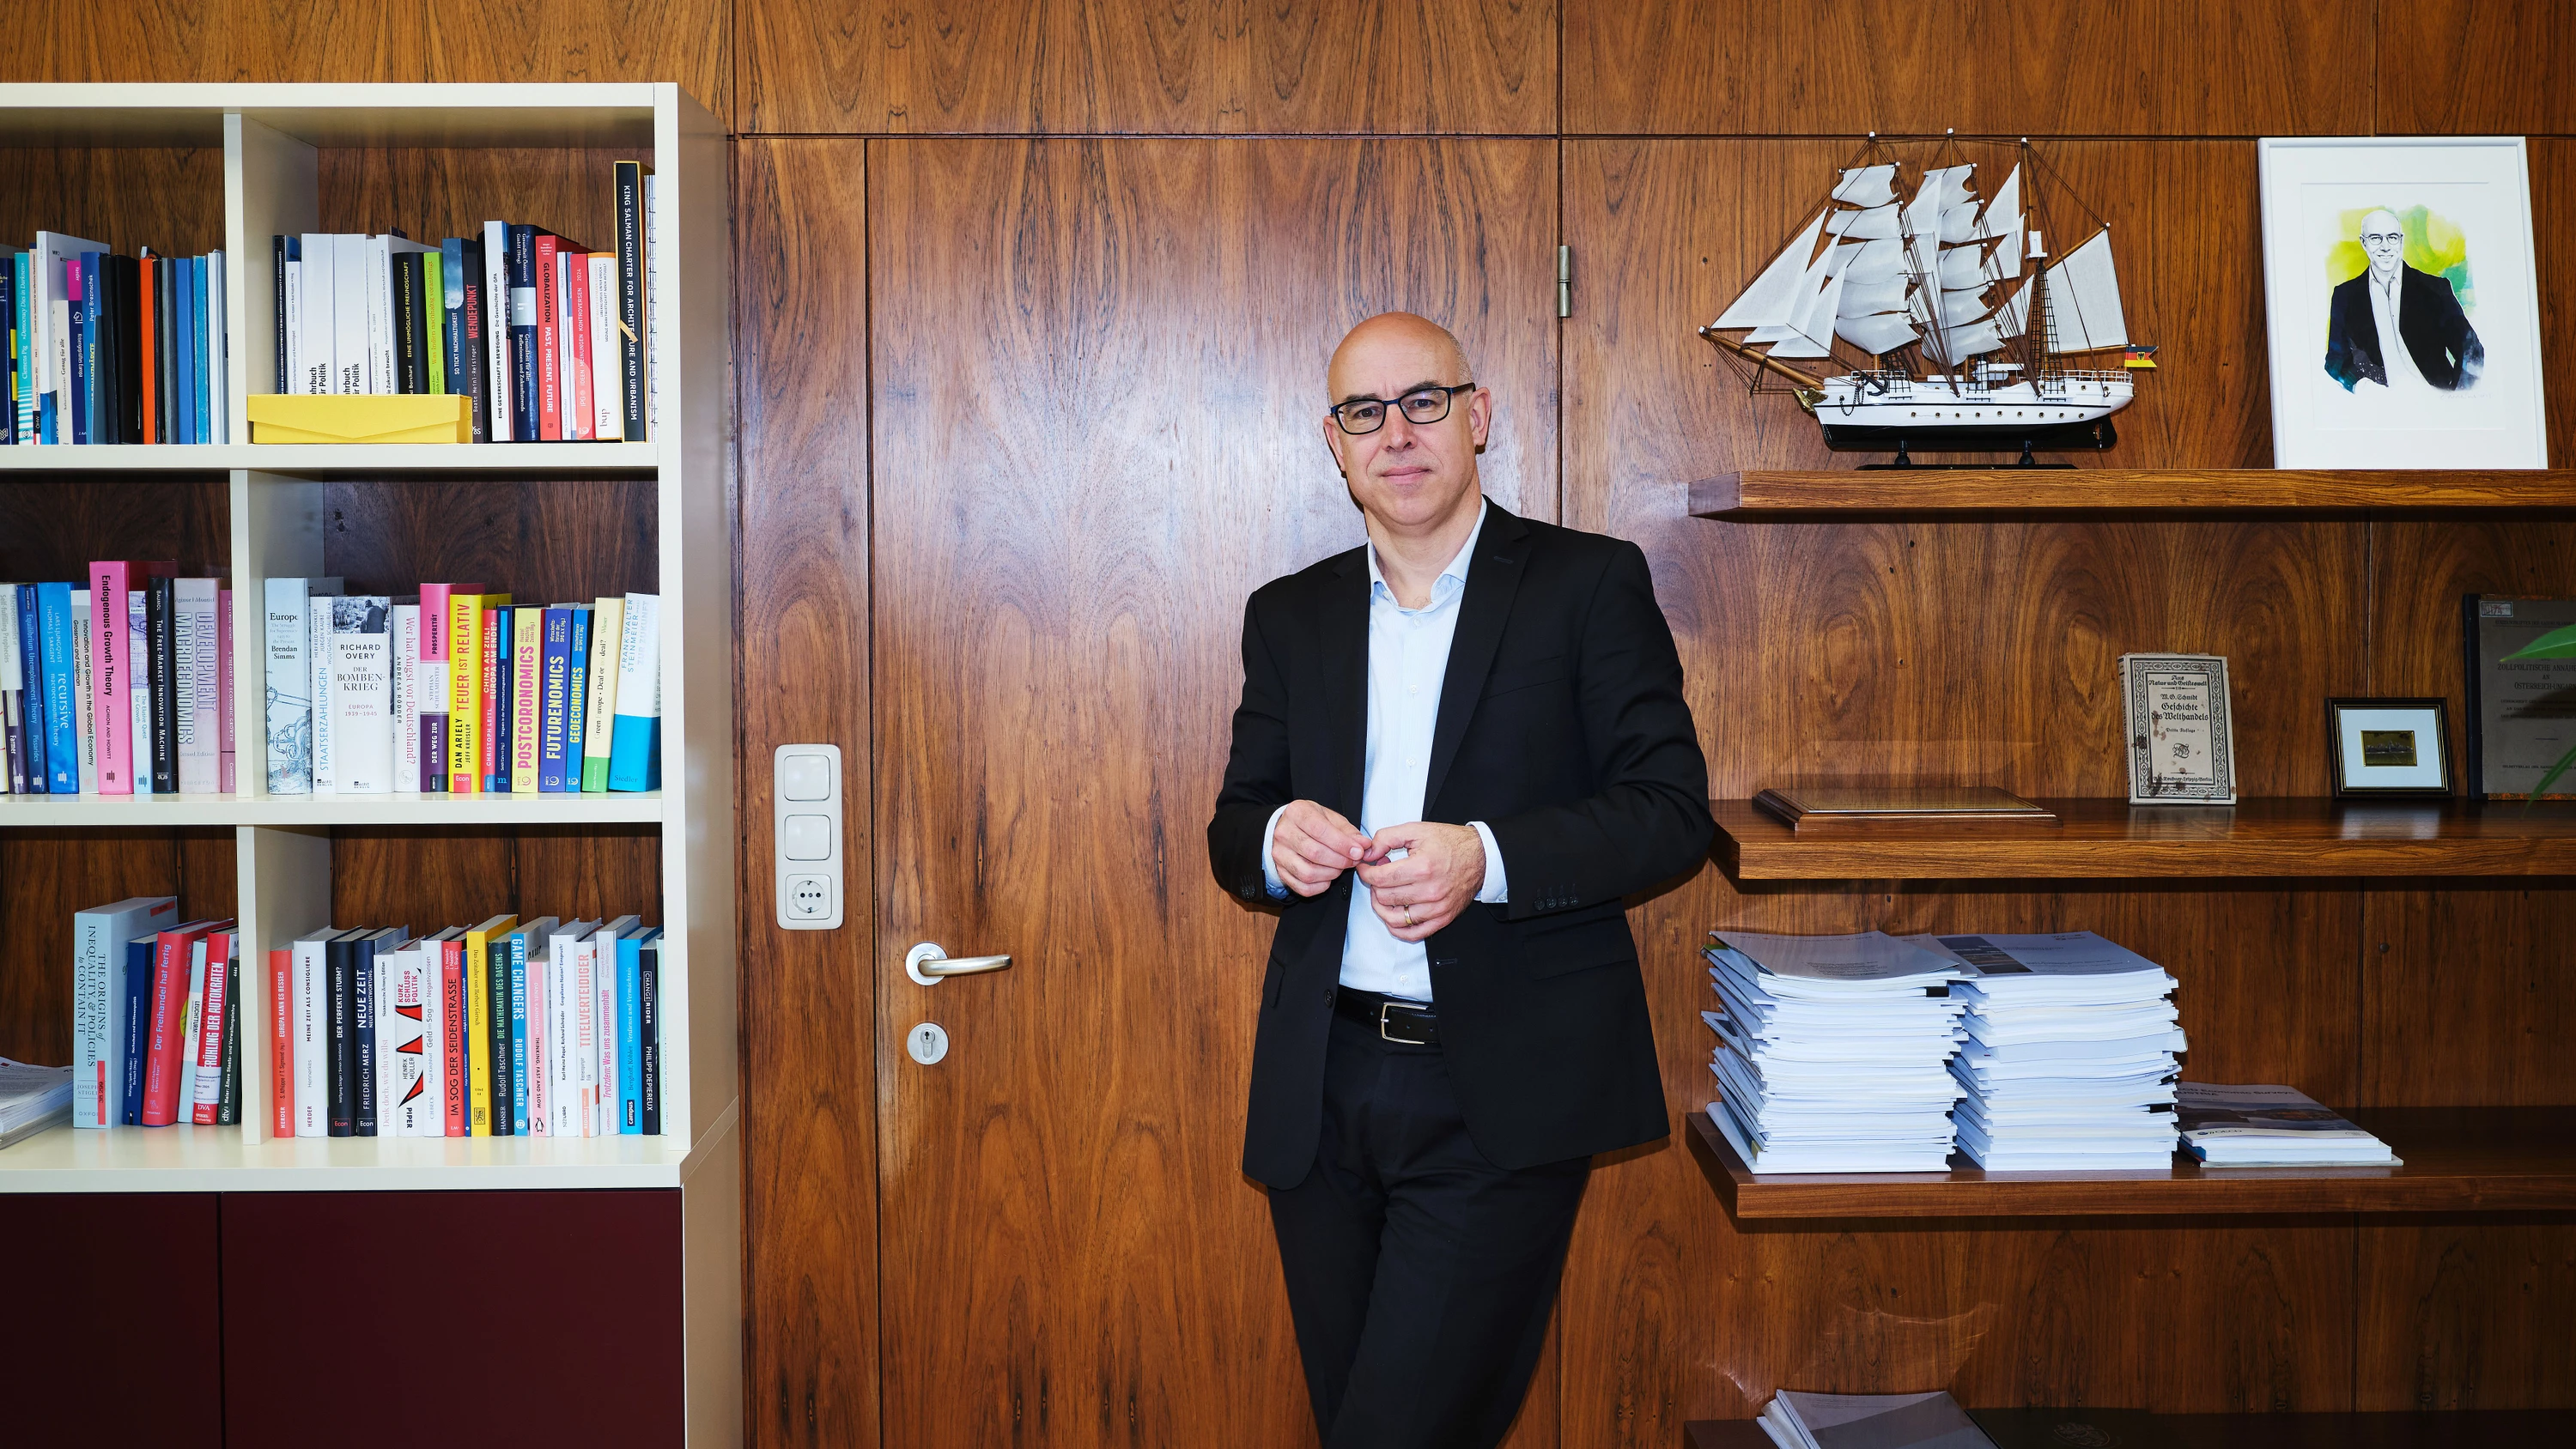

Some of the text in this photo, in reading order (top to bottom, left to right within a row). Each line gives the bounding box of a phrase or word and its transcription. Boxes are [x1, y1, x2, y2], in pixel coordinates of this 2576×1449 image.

[466, 284, 478, 339] WENDEPUNKT
[543, 262, 551, 323] GLOBALIZATION
[577, 334, 587, 368] MEINUNGEN
[627, 298, 636, 357] ARCHITETURE
[318, 363, 326, 387] Politik
[351, 363, 360, 387] Politik
[629, 378, 638, 420] URBANISM
[25, 614, 35, 651] Equilibrium
[100, 575, 114, 696] Endogenous Growth Theory
[456, 603, 470, 712] TEUER IST RELATIV
[484, 651, 490, 664] AM
[490, 650, 497, 664] AM
[28, 652, 38, 702] Unemployment
[175, 612, 194, 744] MACROECONOMICS
[195, 612, 217, 711] DEVELOPMENT
[337, 673, 385, 682] BOMBEN-
[344, 683, 378, 691] KRIEG
[2497, 663, 2576, 672] ZOLLPOLITISCHE ANNÄHE
[30, 702, 38, 724] Theory
[50, 673, 59, 724] macroeconomic
[57, 673, 71, 729] recursive
[403, 617, 417, 765] Wer hat Angst vor Deutschland?
[517, 646, 535, 769] POSTCORONOMICS
[546, 656, 564, 759] FUTURENOMICS
[569, 667, 583, 743] GEOECONOMICS
[2151, 712, 2209, 722] des Welthandels
[2161, 702, 2198, 712] Geschichte
[318, 667, 329, 771] STAATSERZÄHLUNGEN
[454, 718, 463, 768] DAN ARIELY
[159, 969, 168, 985] hat
[161, 944, 172, 968] fertig
[511, 939, 525, 1020] GAME CHANGERS
[78, 965, 86, 1019] CONTAIN
[86, 925, 96, 1067] INEQUALITY, & POLICIES
[95, 953, 106, 1043] THE ORIGINS of
[156, 986, 166, 1033] Freihandel
[208, 962, 224, 1014] AUTOKRATEN
[356, 968, 367, 1028] NEUE ZEIT.
[578, 954, 591, 1048] TITELVERTEIDIGER
[78, 1023, 86, 1035] IT
[154, 1034, 162, 1050] Der
[207, 1015, 221, 1031] DER
[447, 978, 459, 1116] IM SOG DER SEIDENSTRASSE
[497, 1042, 507, 1097] Rudolf Taschner
[515, 1038, 524, 1107] RUDOLF TASCHNER
